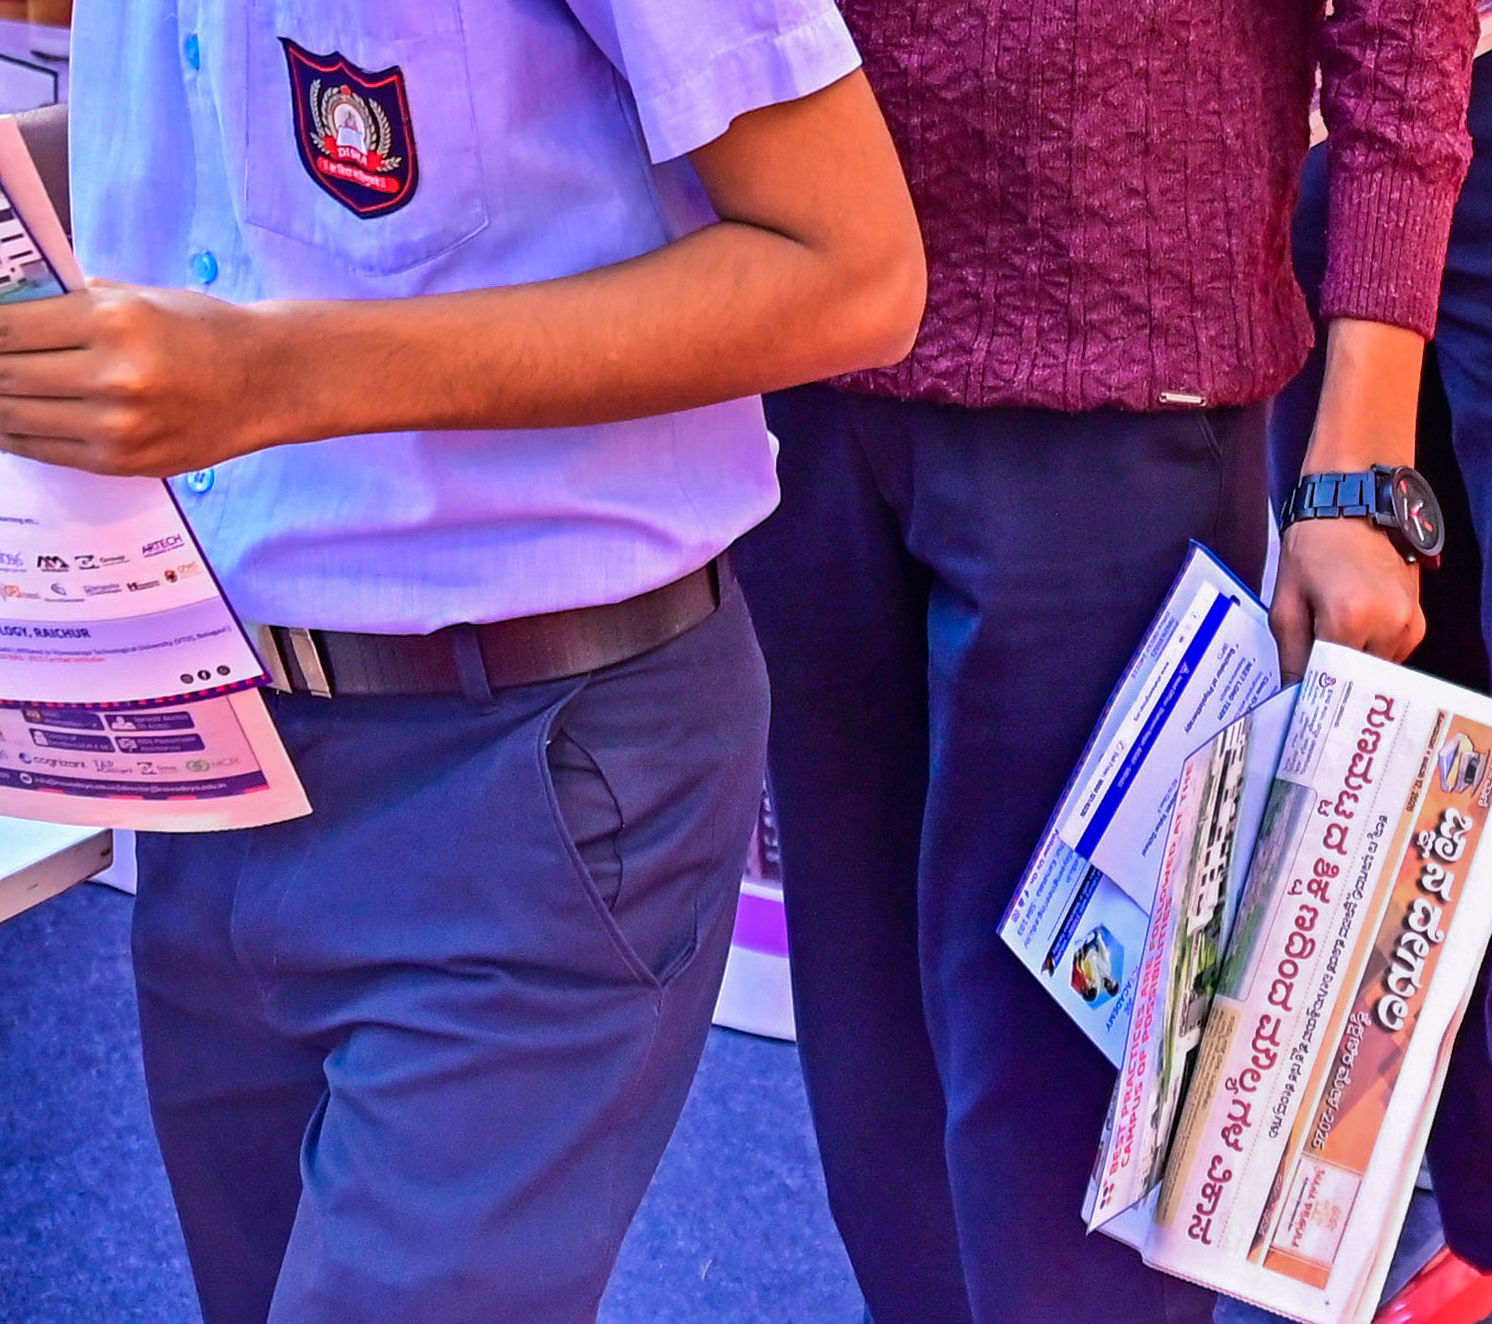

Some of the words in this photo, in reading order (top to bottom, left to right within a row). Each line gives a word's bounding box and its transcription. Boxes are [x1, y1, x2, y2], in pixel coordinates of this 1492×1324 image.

[337, 147, 368, 166] DISHA
[33, 627, 91, 639] RAICHUR
[1317, 694, 1395, 856] ಗುಣಮಟ್ಟದ
[1110, 1148, 1126, 1176] BEST
[1121, 1004, 1145, 1117] PRACTICES
[1141, 960, 1153, 998] ARE
[1149, 841, 1176, 953] FOLLOWED
[1172, 812, 1184, 835] AT
[1178, 762, 1194, 803] THE
[1142, 897, 1173, 1043] POSSIBILITIES
[1268, 858, 1339, 1012] ಶಿಕ್ಷಣದಿಂದ
[1137, 1051, 1148, 1077] OF
[1221, 1014, 1281, 1152] ಮೌಲ್ಯಗಳ
[1121, 1079, 1143, 1168] CAMPUS
[1188, 1155, 1233, 1245] ವಿಕಾಸ
